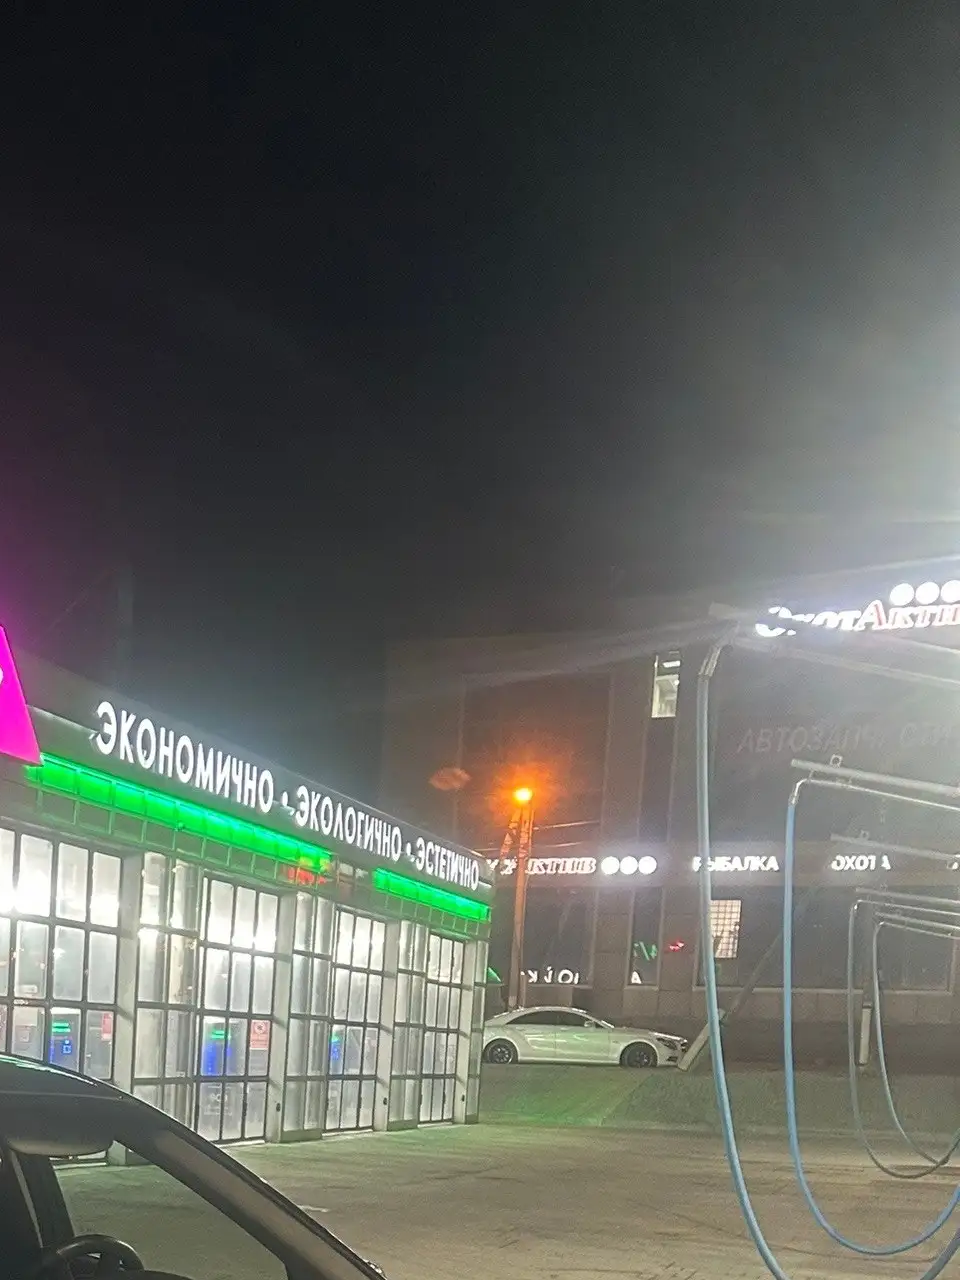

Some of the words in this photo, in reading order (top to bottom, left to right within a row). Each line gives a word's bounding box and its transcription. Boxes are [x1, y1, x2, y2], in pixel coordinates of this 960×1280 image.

[96, 701, 274, 813] ЭКОНОМИЧНО
[295, 786, 403, 863] ЭКОЛОГИЧНО
[415, 836, 480, 892] ЭСТЕТИЧНО
